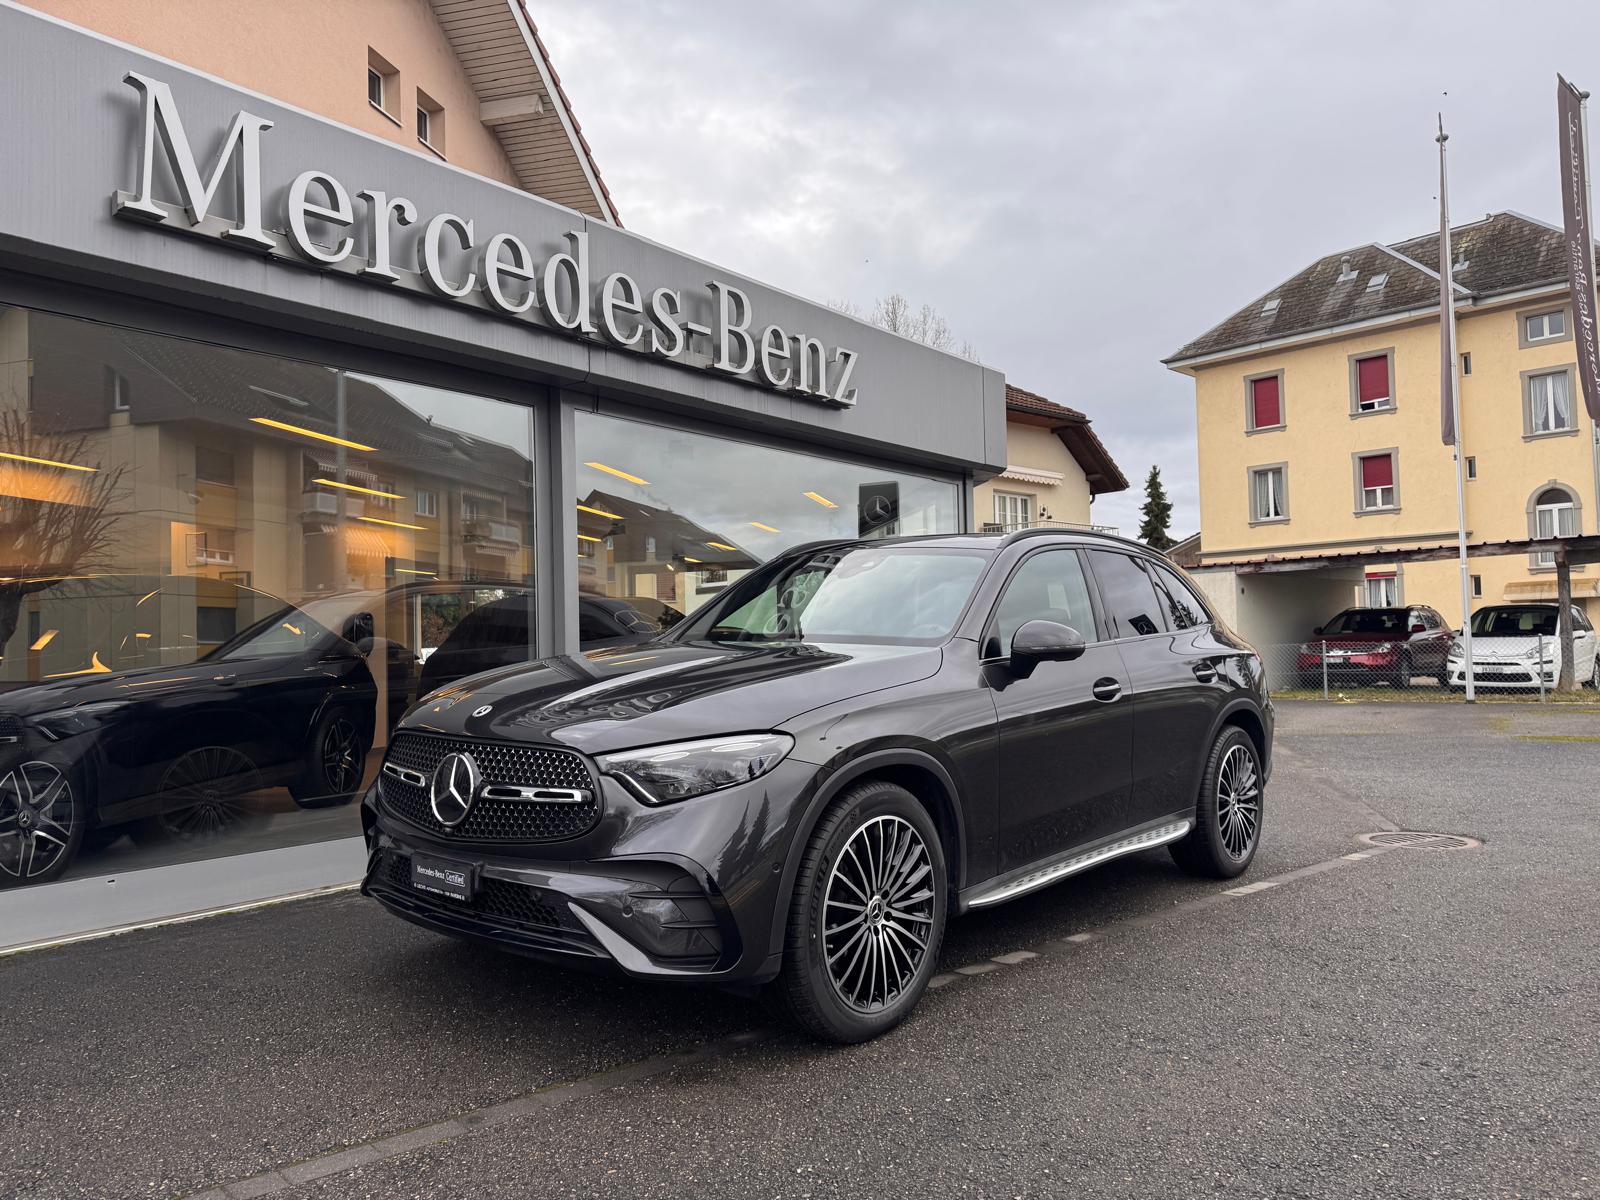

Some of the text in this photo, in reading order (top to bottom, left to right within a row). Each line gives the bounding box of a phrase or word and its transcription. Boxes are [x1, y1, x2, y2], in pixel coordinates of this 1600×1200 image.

[118, 70, 859, 407] Mercedes-Benz
[416, 865, 464, 885] Mercedes-Benz Certified
